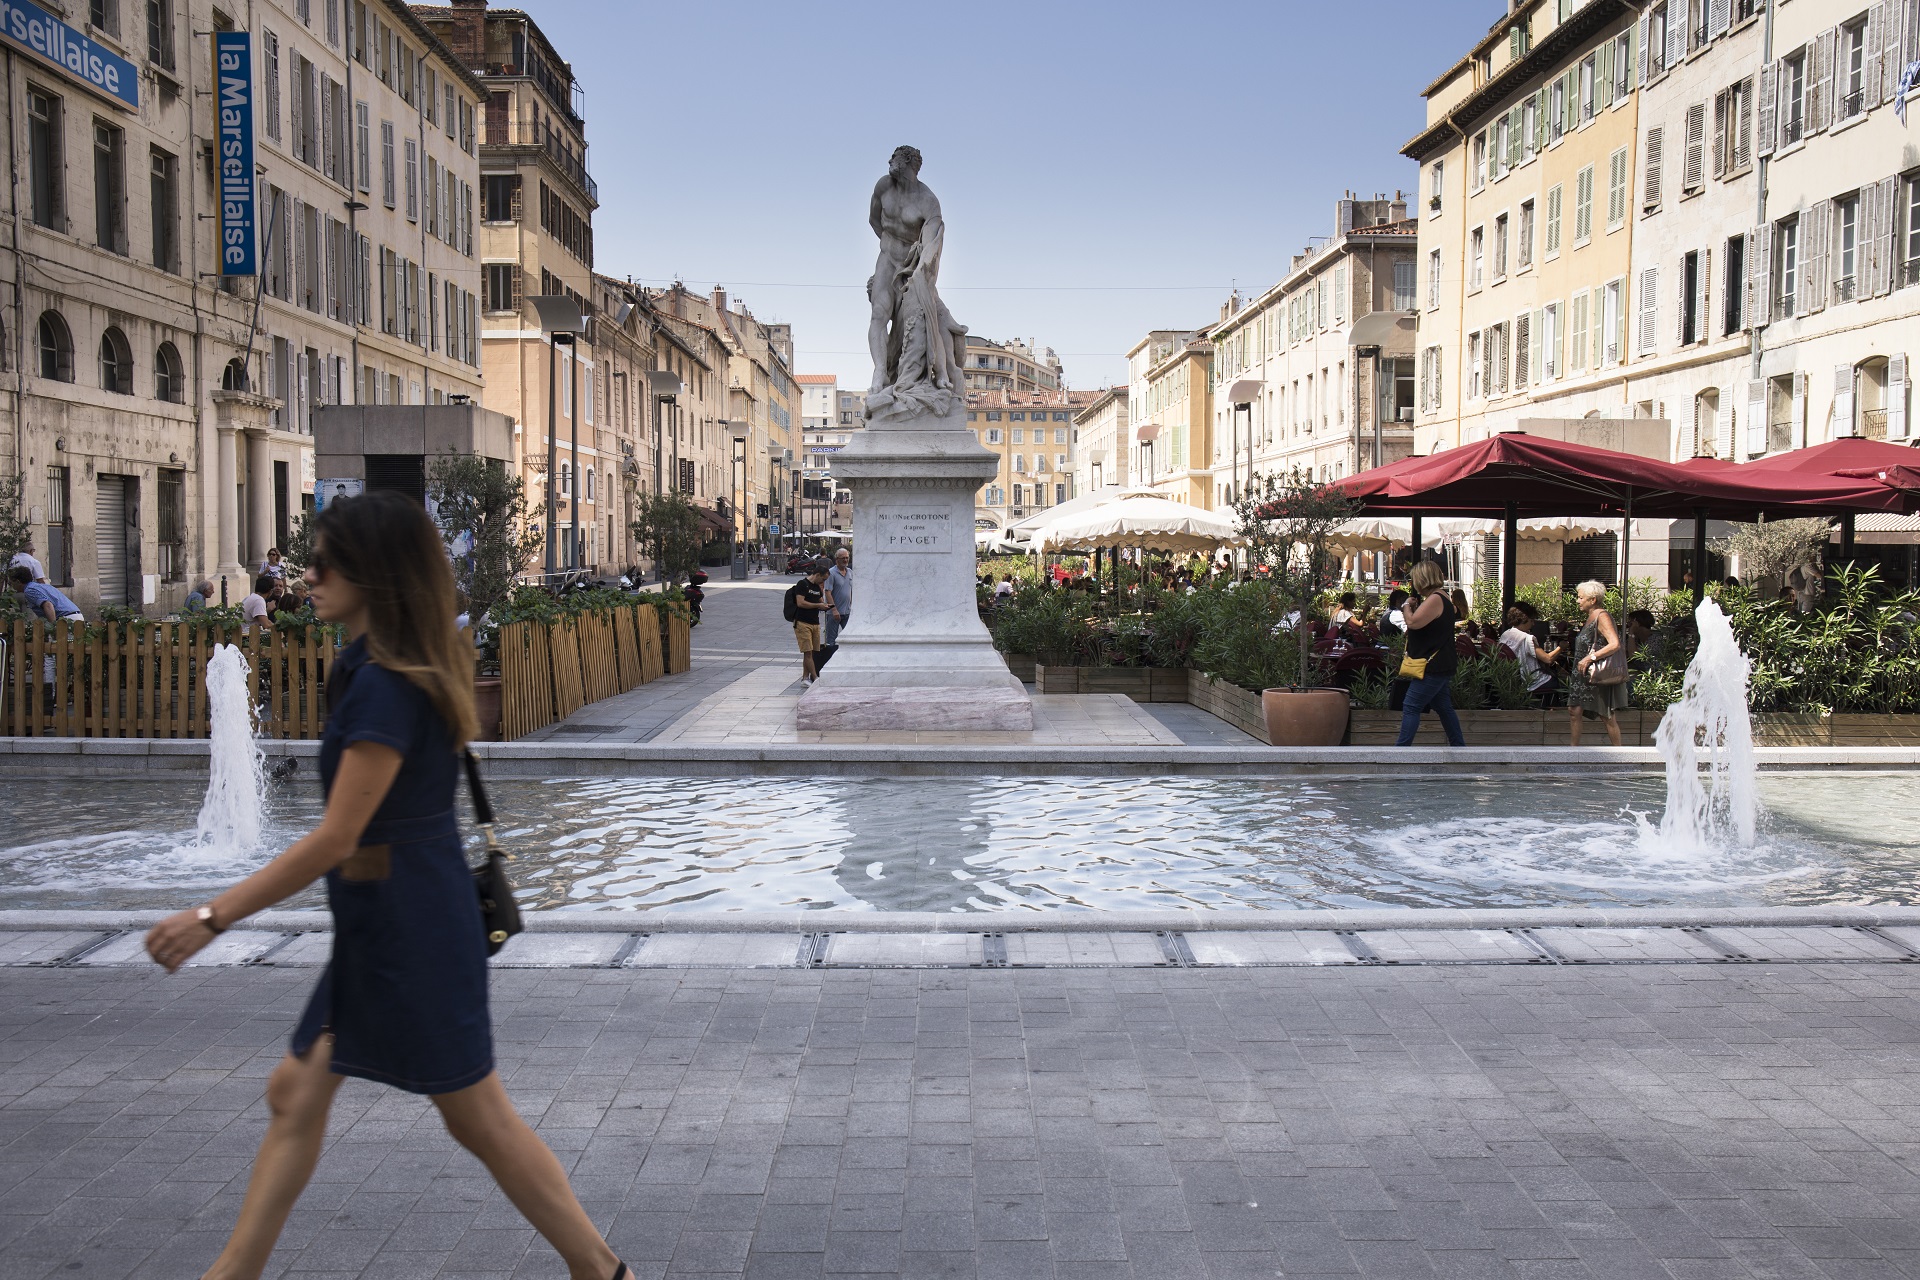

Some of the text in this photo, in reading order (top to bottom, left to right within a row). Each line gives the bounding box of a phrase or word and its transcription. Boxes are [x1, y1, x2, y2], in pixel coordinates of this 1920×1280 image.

[0, 0, 119, 93] rseillaise
[220, 44, 250, 265] la Marseillaise
